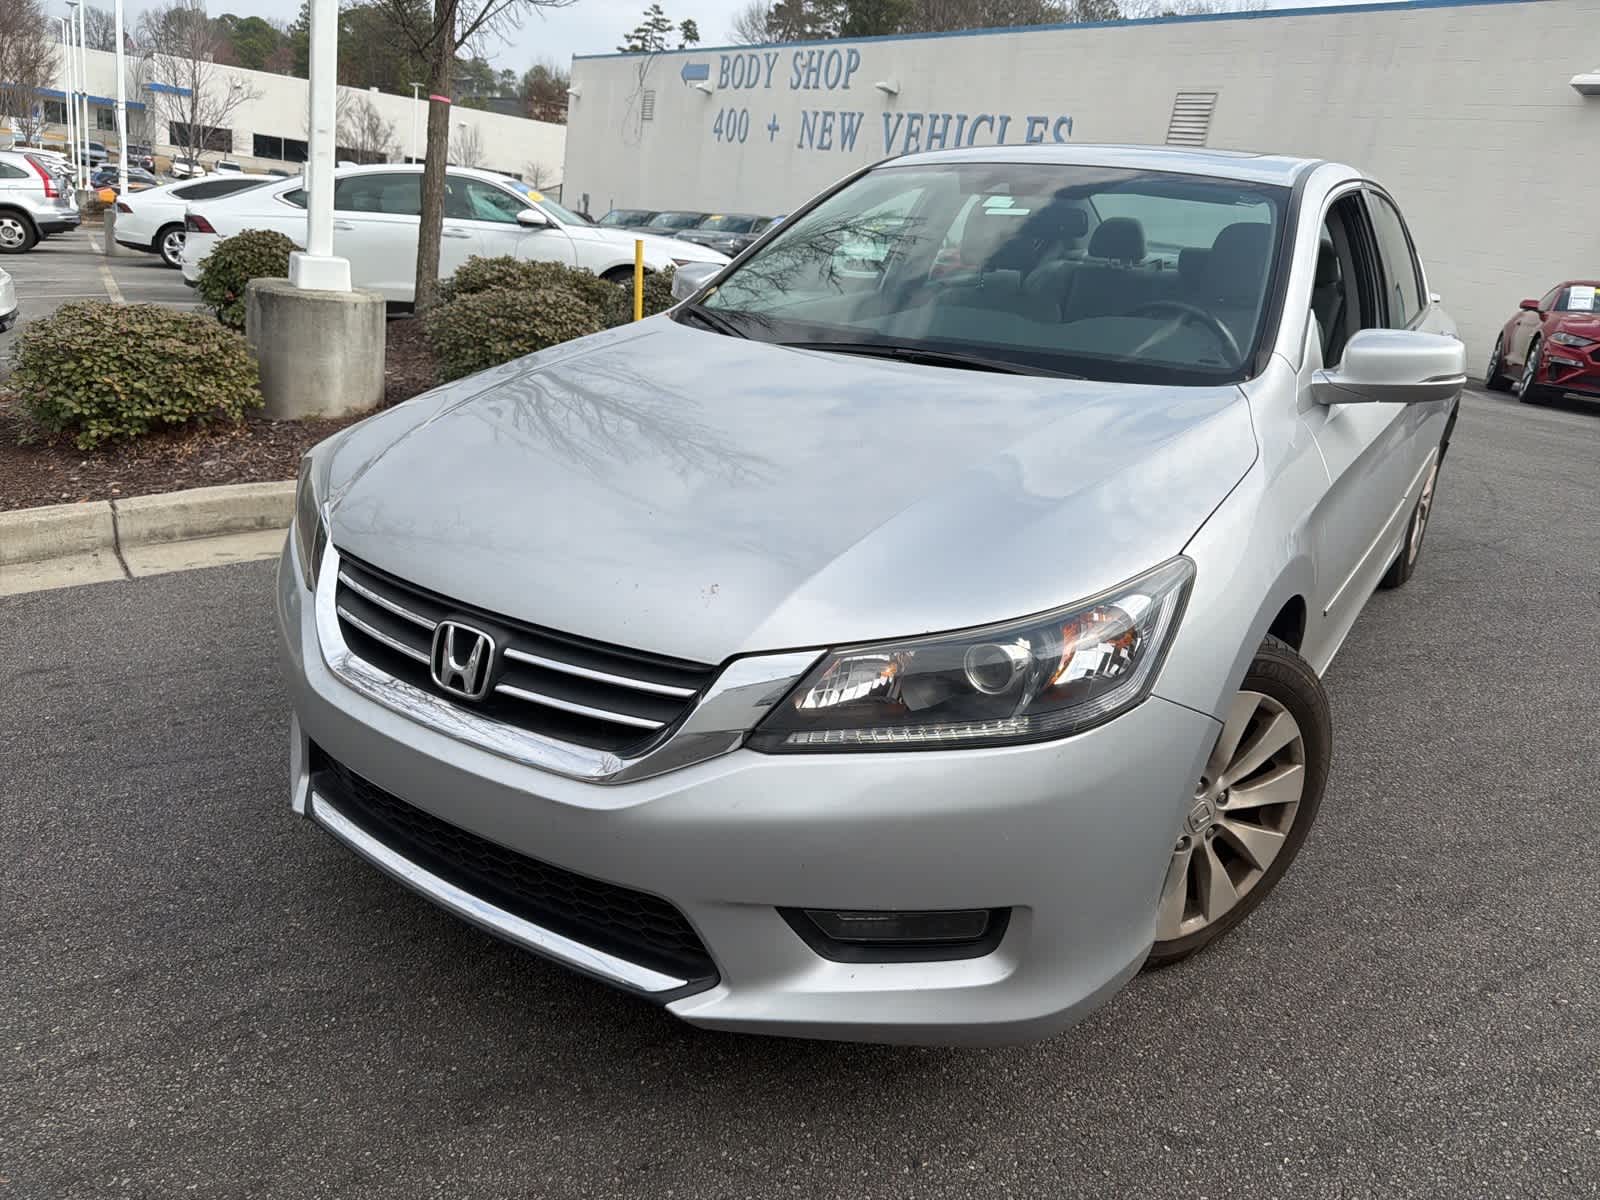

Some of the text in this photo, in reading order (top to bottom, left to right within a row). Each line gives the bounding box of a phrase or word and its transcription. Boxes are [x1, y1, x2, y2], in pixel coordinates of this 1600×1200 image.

[717, 48, 861, 90] BODY SHOP
[713, 107, 750, 144] 400
[767, 112, 780, 142] +
[797, 110, 865, 153] NEW
